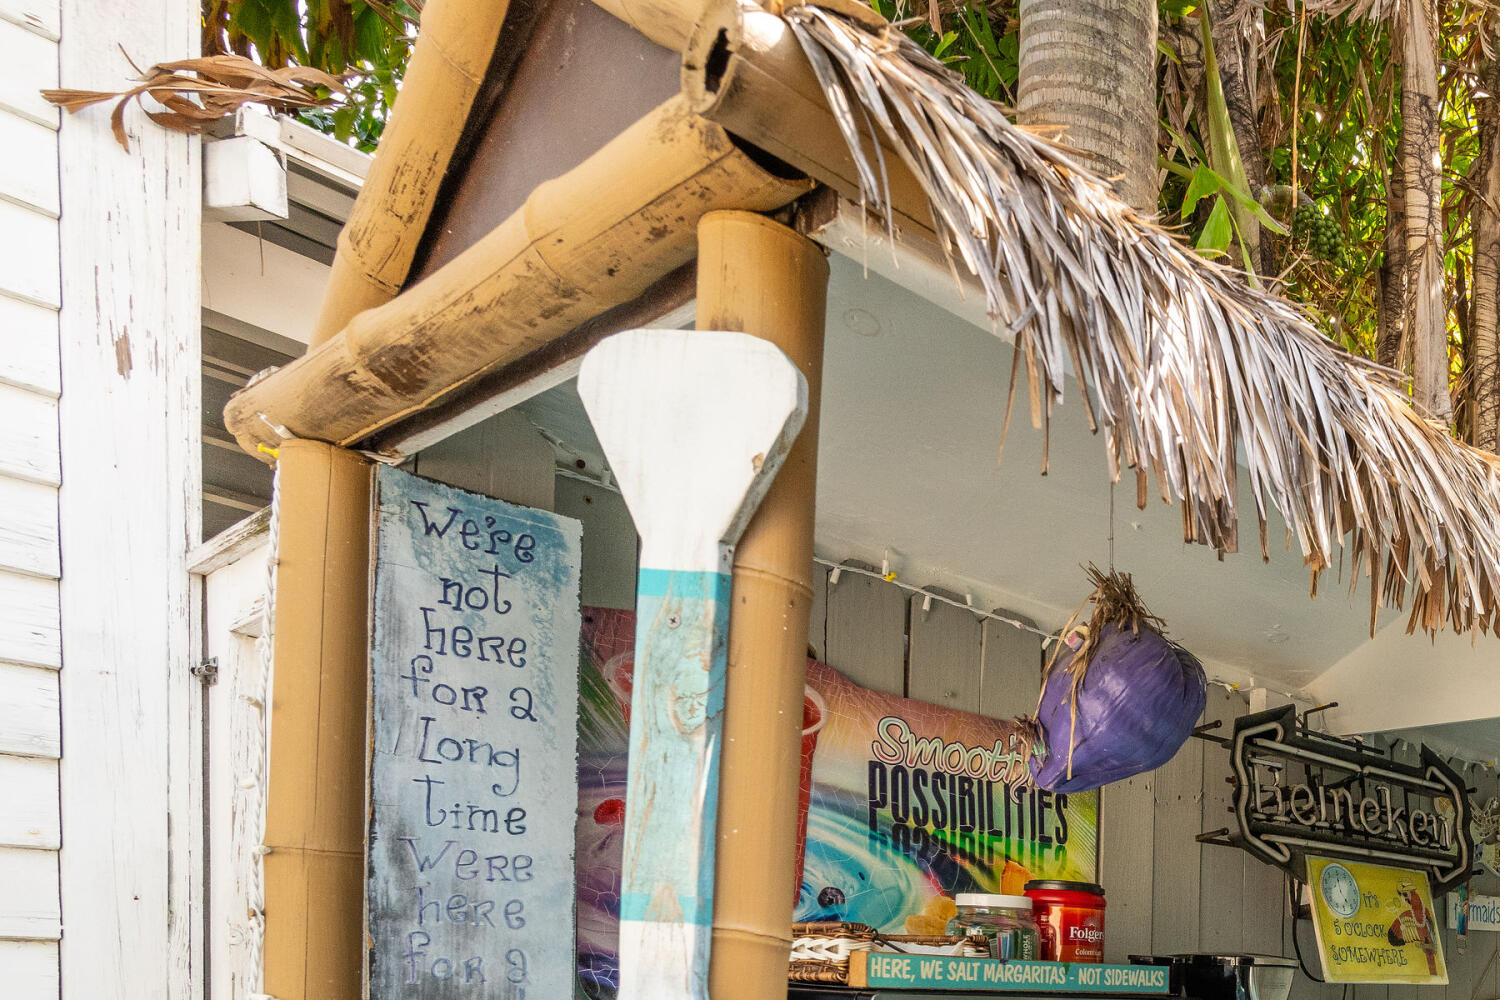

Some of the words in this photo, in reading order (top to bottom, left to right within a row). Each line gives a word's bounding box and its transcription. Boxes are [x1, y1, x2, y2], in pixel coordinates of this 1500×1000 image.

[410, 500, 536, 563] We're
[438, 565, 512, 614] not
[420, 607, 527, 668] here
[401, 655, 488, 714] for
[509, 687, 538, 722] a
[419, 717, 520, 797] Long
[872, 716, 1033, 804] Smooth
[412, 775, 527, 835] time
[868, 760, 1068, 844] POSSIBILITIES
[1248, 752, 1451, 850] Heineken
[414, 885, 526, 930] here
[1333, 918, 1341, 935] 5
[1454, 900, 1500, 924] rmaids
[402, 931, 486, 985] for
[505, 948, 527, 984] a
[870, 957, 916, 981] HERE,
[920, 960, 943, 981] WE
[947, 962, 981, 982] SALT
[983, 964, 1066, 985] MARGARITAS
[1078, 968, 1101, 985] NOT
[1104, 968, 1164, 987] SIDEWALKS
[1331, 945, 1408, 967] SOMEWHERE
